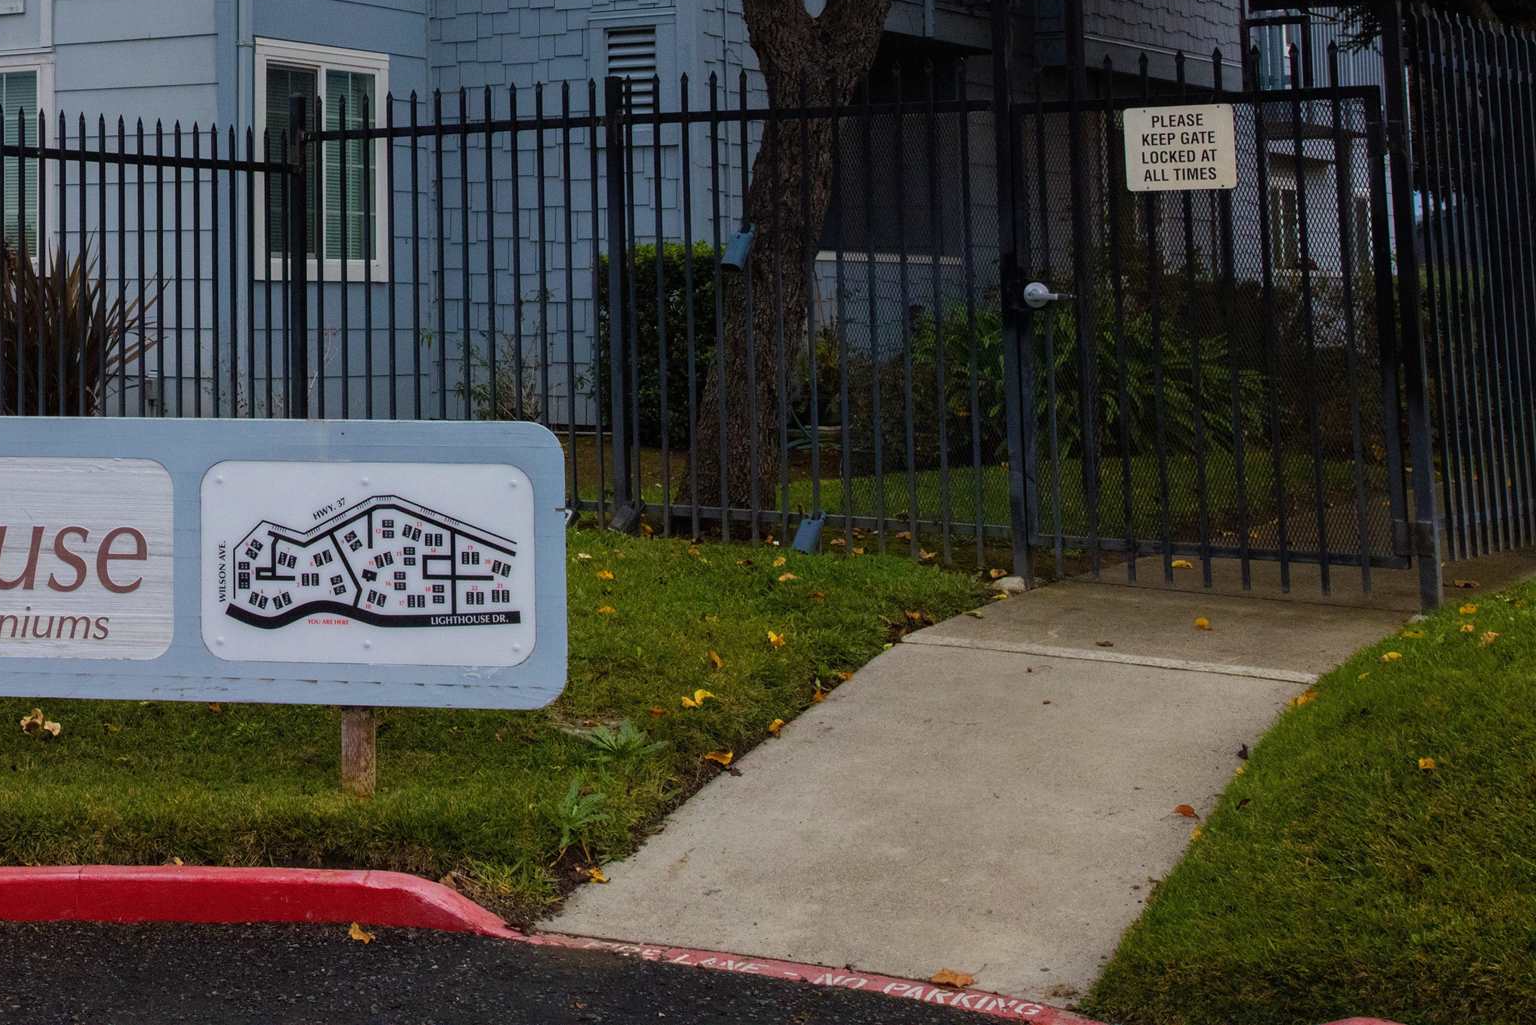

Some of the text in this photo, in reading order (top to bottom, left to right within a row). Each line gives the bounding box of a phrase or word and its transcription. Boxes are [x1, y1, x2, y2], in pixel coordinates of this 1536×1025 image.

[1151, 113, 1204, 128] PLEASE
[1142, 130, 1216, 146] KEEP GATE
[1142, 148, 1218, 165] LOCKED AT
[1144, 166, 1217, 182] ALL TIMES
[312, 496, 346, 520] HWY. 37
[431, 615, 509, 625] LIGHTHOUSE DR.
[813, 973, 868, 989] NO
[884, 983, 1044, 1016] PARKING
